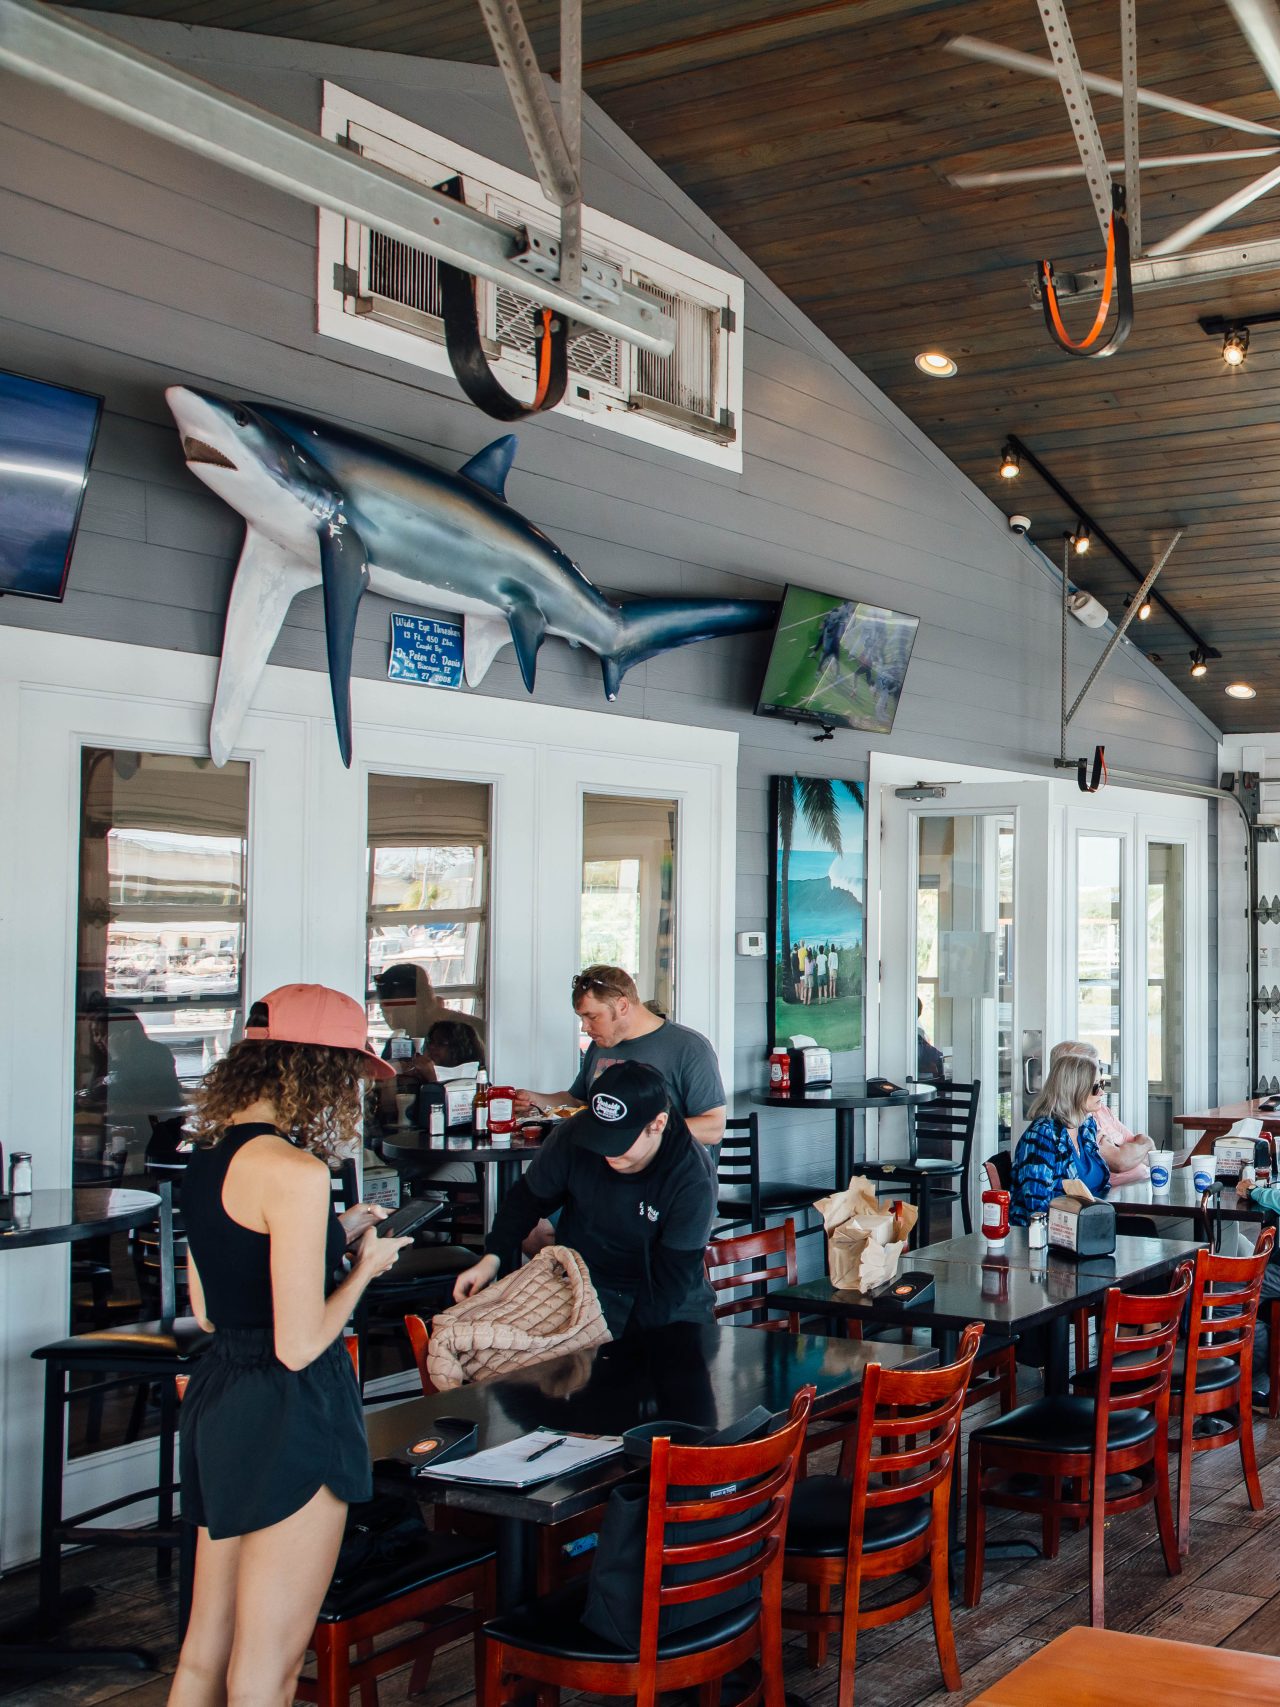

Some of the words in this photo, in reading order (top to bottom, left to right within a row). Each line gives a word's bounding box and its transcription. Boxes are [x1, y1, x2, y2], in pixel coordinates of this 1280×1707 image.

[395, 617, 414, 629] Wide
[418, 621, 430, 633] Eye
[403, 631, 411, 639] 13
[426, 635, 438, 643] 450
[409, 650, 427, 662] Peter
[430, 654, 438, 664] G.
[442, 656, 460, 667] Davis
